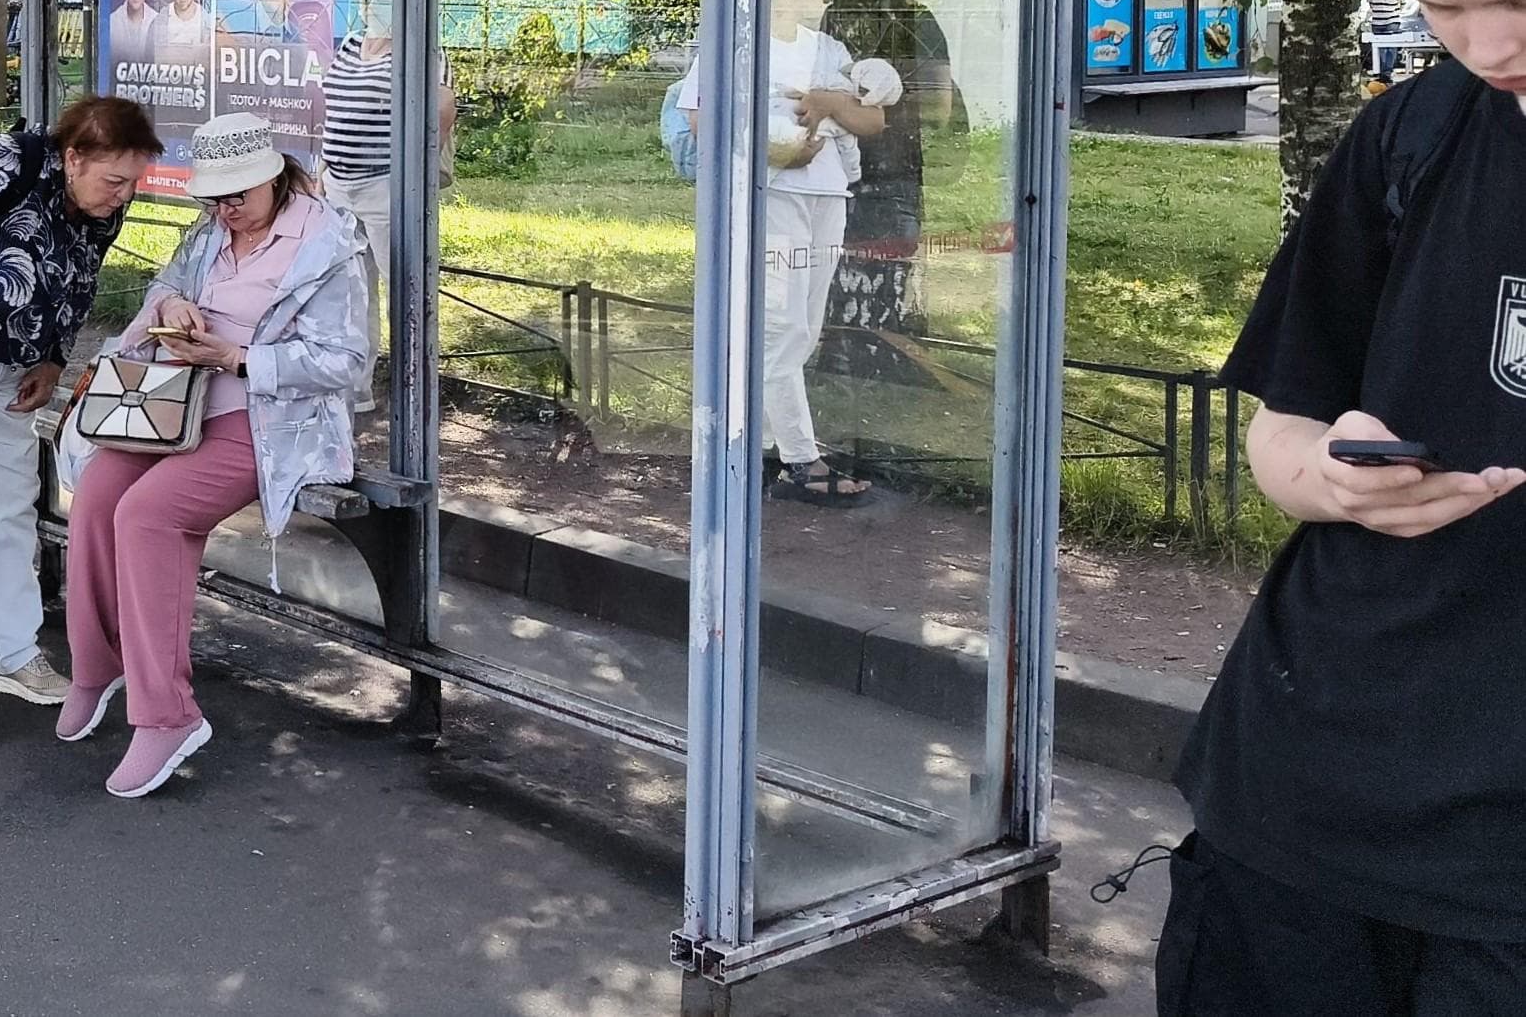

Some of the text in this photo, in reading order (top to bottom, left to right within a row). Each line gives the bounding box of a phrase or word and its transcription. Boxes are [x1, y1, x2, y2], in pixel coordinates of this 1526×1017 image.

[116, 62, 205, 86] GAYAZOV$
[219, 47, 323, 88] BIICLA
[116, 85, 206, 111] BROTHER$
[230, 95, 262, 106] IZOTOV
[269, 98, 313, 110] MASHKOV
[146, 176, 188, 188] БИЛЕТЫ
